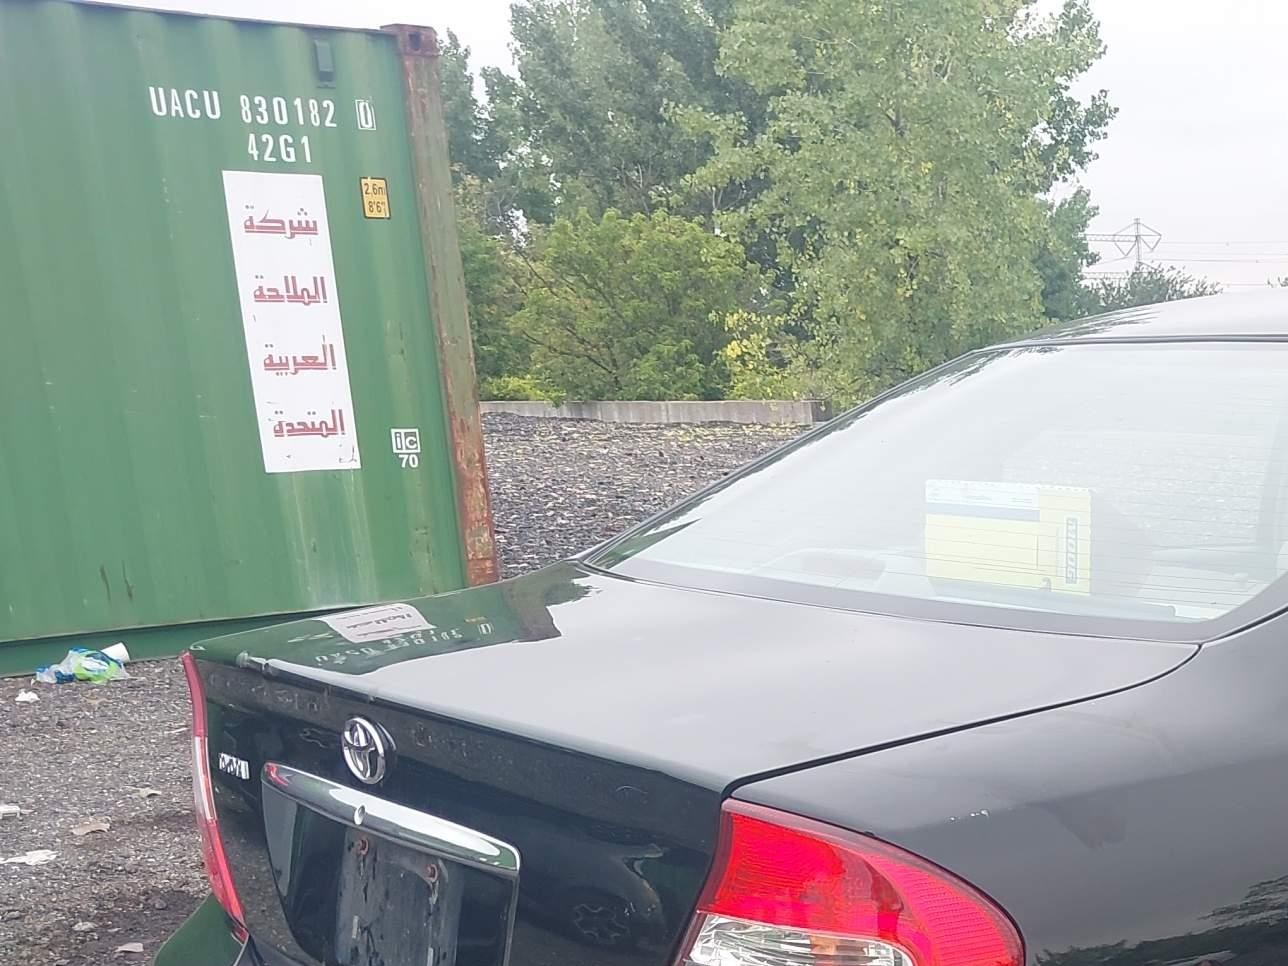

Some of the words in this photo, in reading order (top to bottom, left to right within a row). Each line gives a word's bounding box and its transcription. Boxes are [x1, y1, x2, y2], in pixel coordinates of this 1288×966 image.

[149, 87, 221, 119] UACU
[240, 95, 337, 127] 830182
[248, 133, 312, 163] 42G1
[243, 204, 318, 239] شركة
[253, 275, 328, 306] الملاحة
[263, 342, 337, 376] العربية
[273, 408, 346, 438] المتحدة
[398, 454, 419, 468] 70
